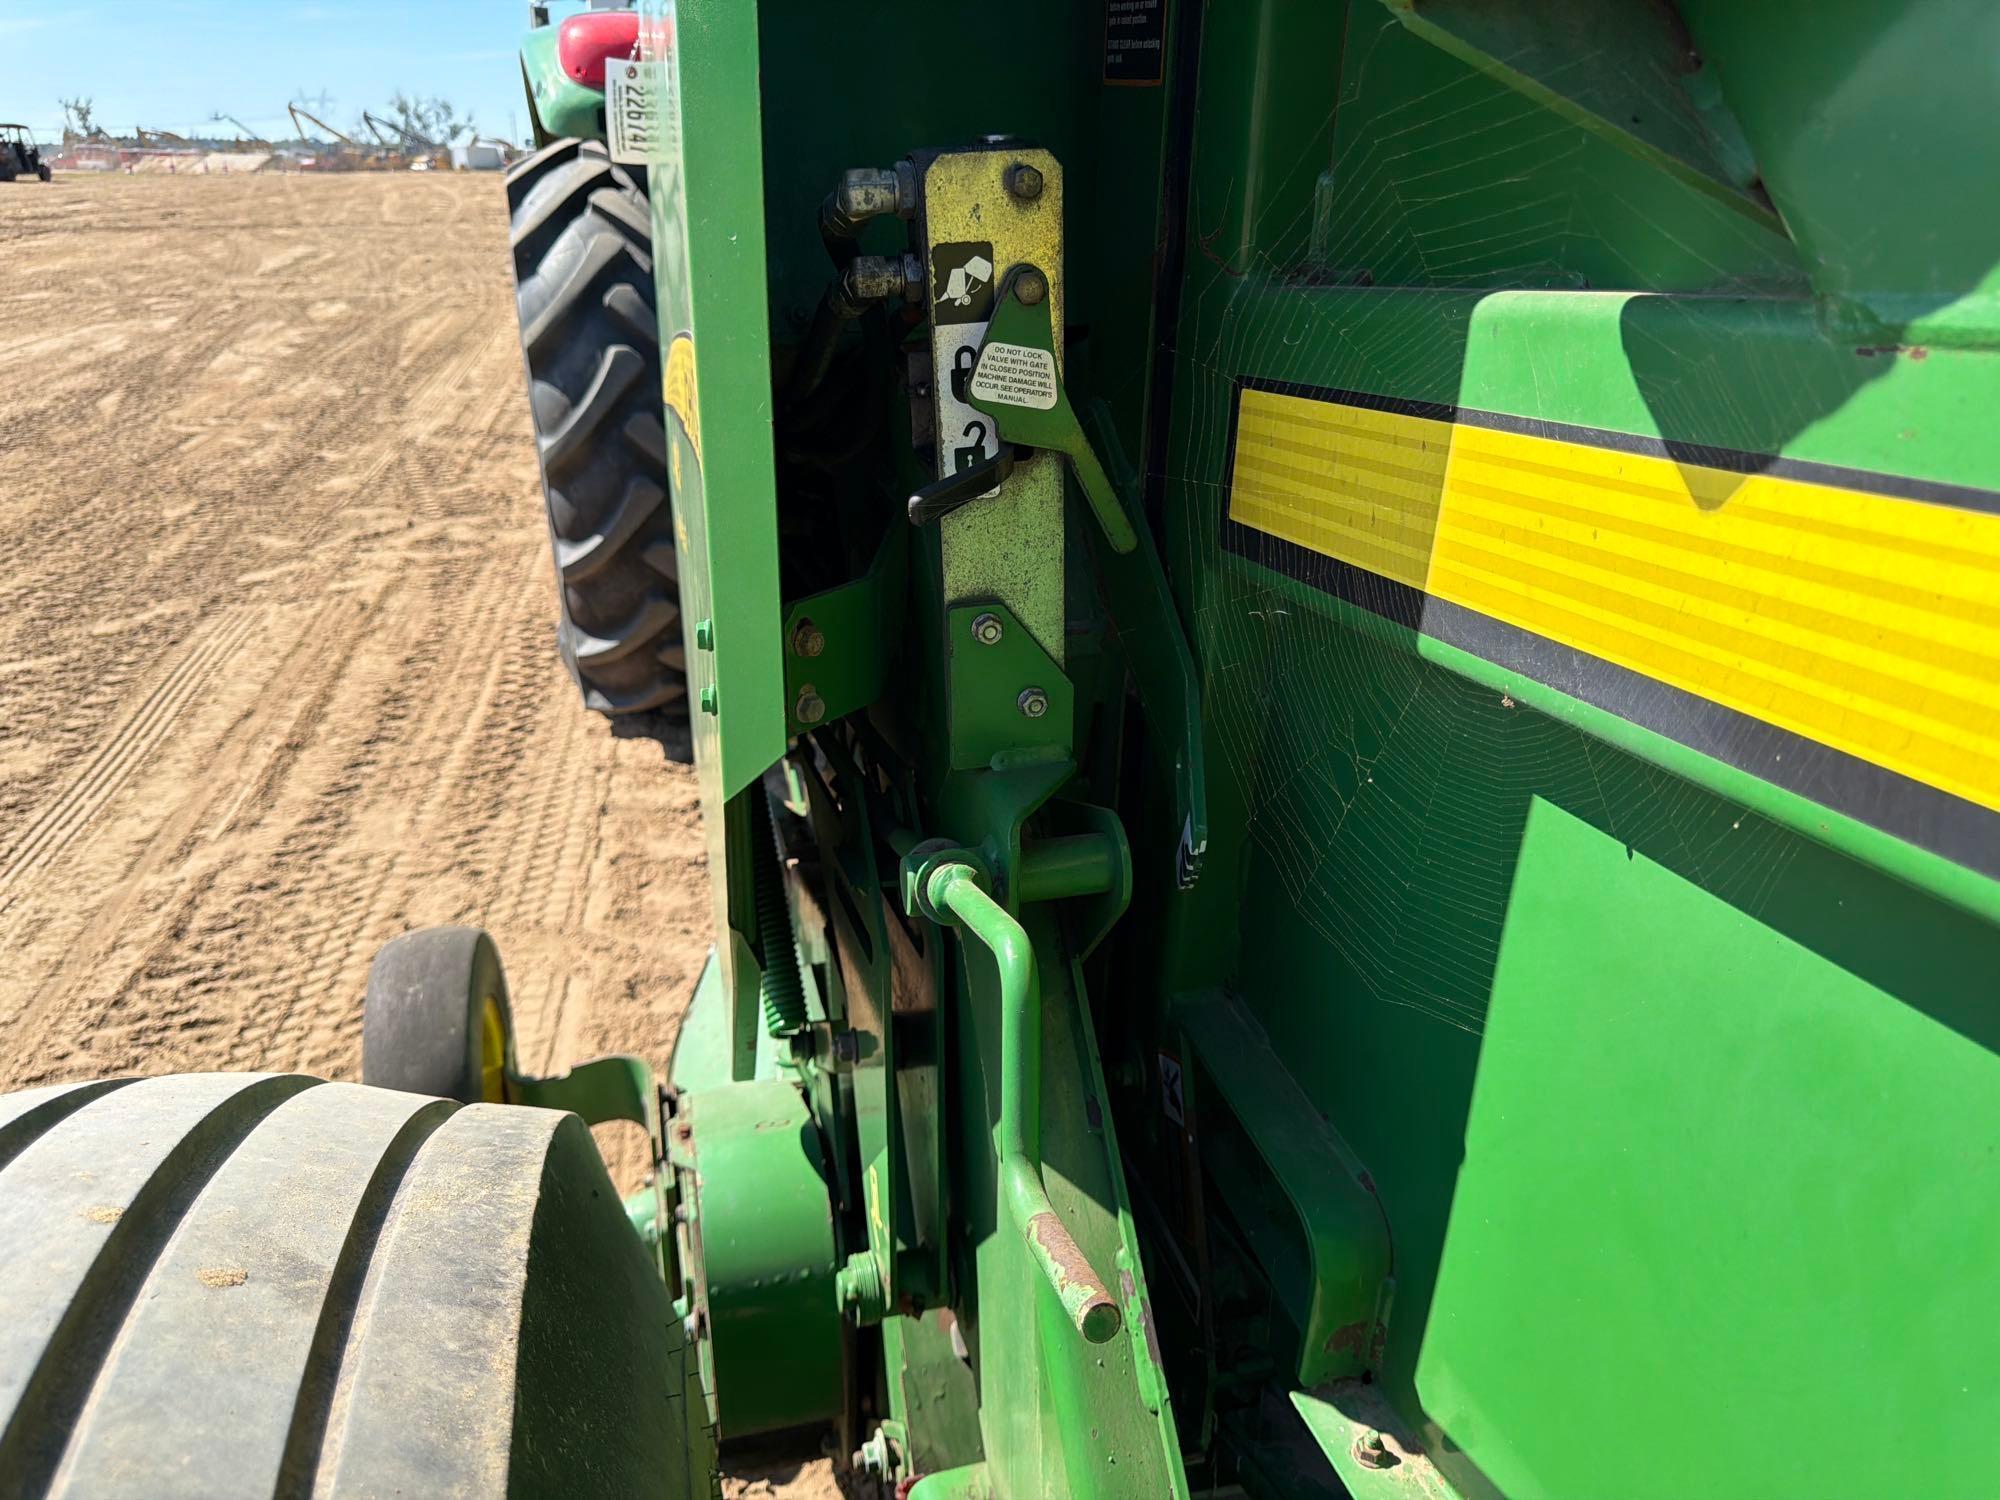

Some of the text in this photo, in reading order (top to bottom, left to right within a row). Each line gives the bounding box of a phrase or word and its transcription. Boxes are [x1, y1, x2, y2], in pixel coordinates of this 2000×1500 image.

[994, 346, 1043, 360] DO NOT LOCK
[987, 354, 1049, 370] VALVE WITH GATE
[989, 364, 1017, 375] CLOSED
[977, 372, 1053, 389] MACHINE DAMAGE WILL
[975, 380, 1053, 398] OCCUR. SEE OPERATOR'S
[997, 393, 1029, 404] MANUAL.
